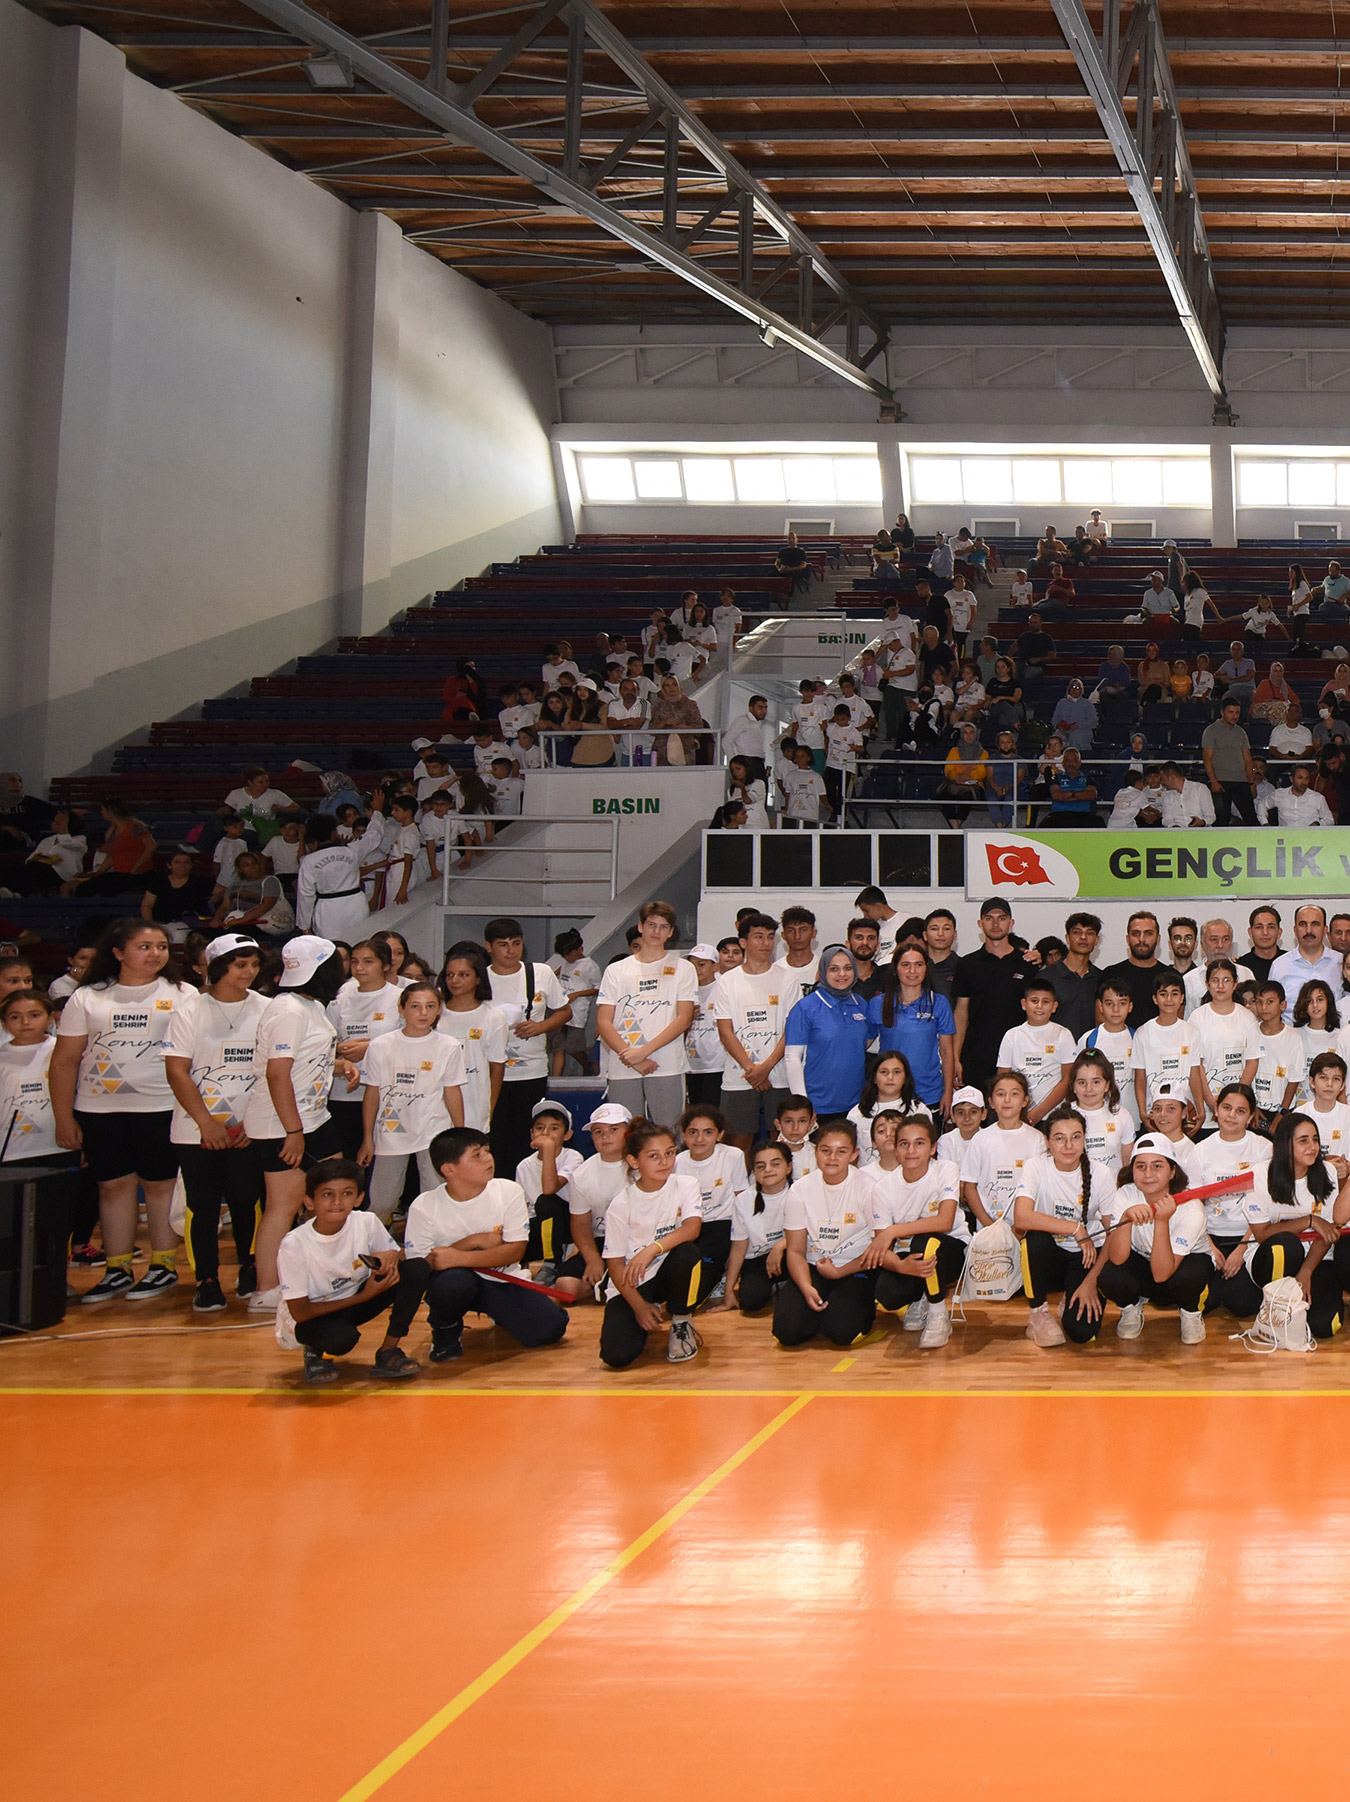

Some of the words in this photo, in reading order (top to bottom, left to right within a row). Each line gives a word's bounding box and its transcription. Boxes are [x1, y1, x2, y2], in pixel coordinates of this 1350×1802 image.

[818, 633, 866, 644] BASIN
[593, 798, 660, 814] BASIN
[1109, 839, 1324, 886] GENÇLİK
[190, 1065, 258, 1092] Kony
[4, 1095, 50, 1110] Kony
